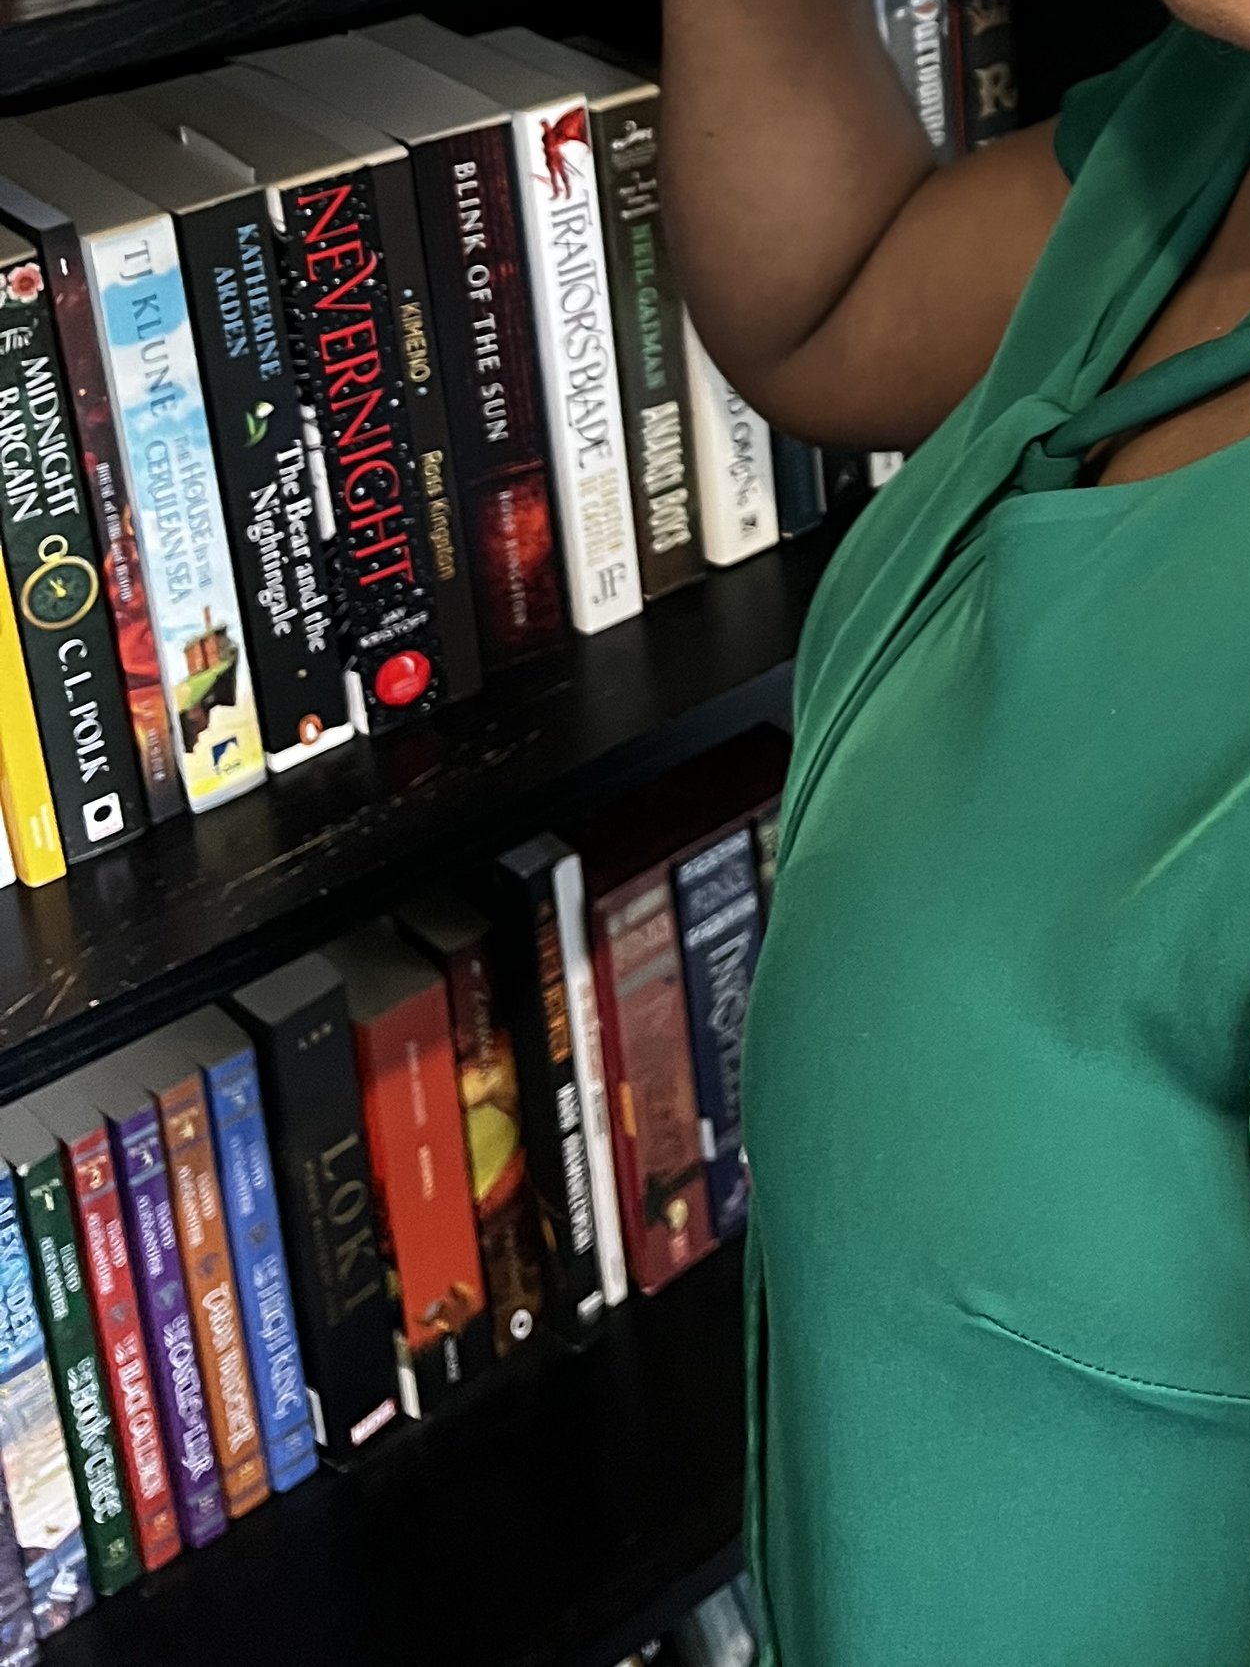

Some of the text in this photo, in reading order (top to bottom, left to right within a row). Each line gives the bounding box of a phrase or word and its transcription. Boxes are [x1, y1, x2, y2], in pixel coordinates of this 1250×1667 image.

[120, 239, 177, 417] TJ KLUNE
[213, 267, 249, 359] ARDEN
[237, 223, 283, 382] KATHERINE
[454, 161, 509, 444] BLINK OF THE SUN
[0, 387, 43, 522] BARGAIN
[21, 356, 80, 517] MIDNIGHT
[296, 185, 415, 586] NEVERNIGHT
[568, 362, 613, 471] BLADE
[144, 440, 192, 605] CERULEAN SEA
[179, 461, 207, 537] HOUSE
[246, 481, 299, 636] Nightingale
[276, 439, 333, 654] The Bear and the
[69, 699, 110, 785] POLK
[321, 1132, 382, 1313] LOKI
